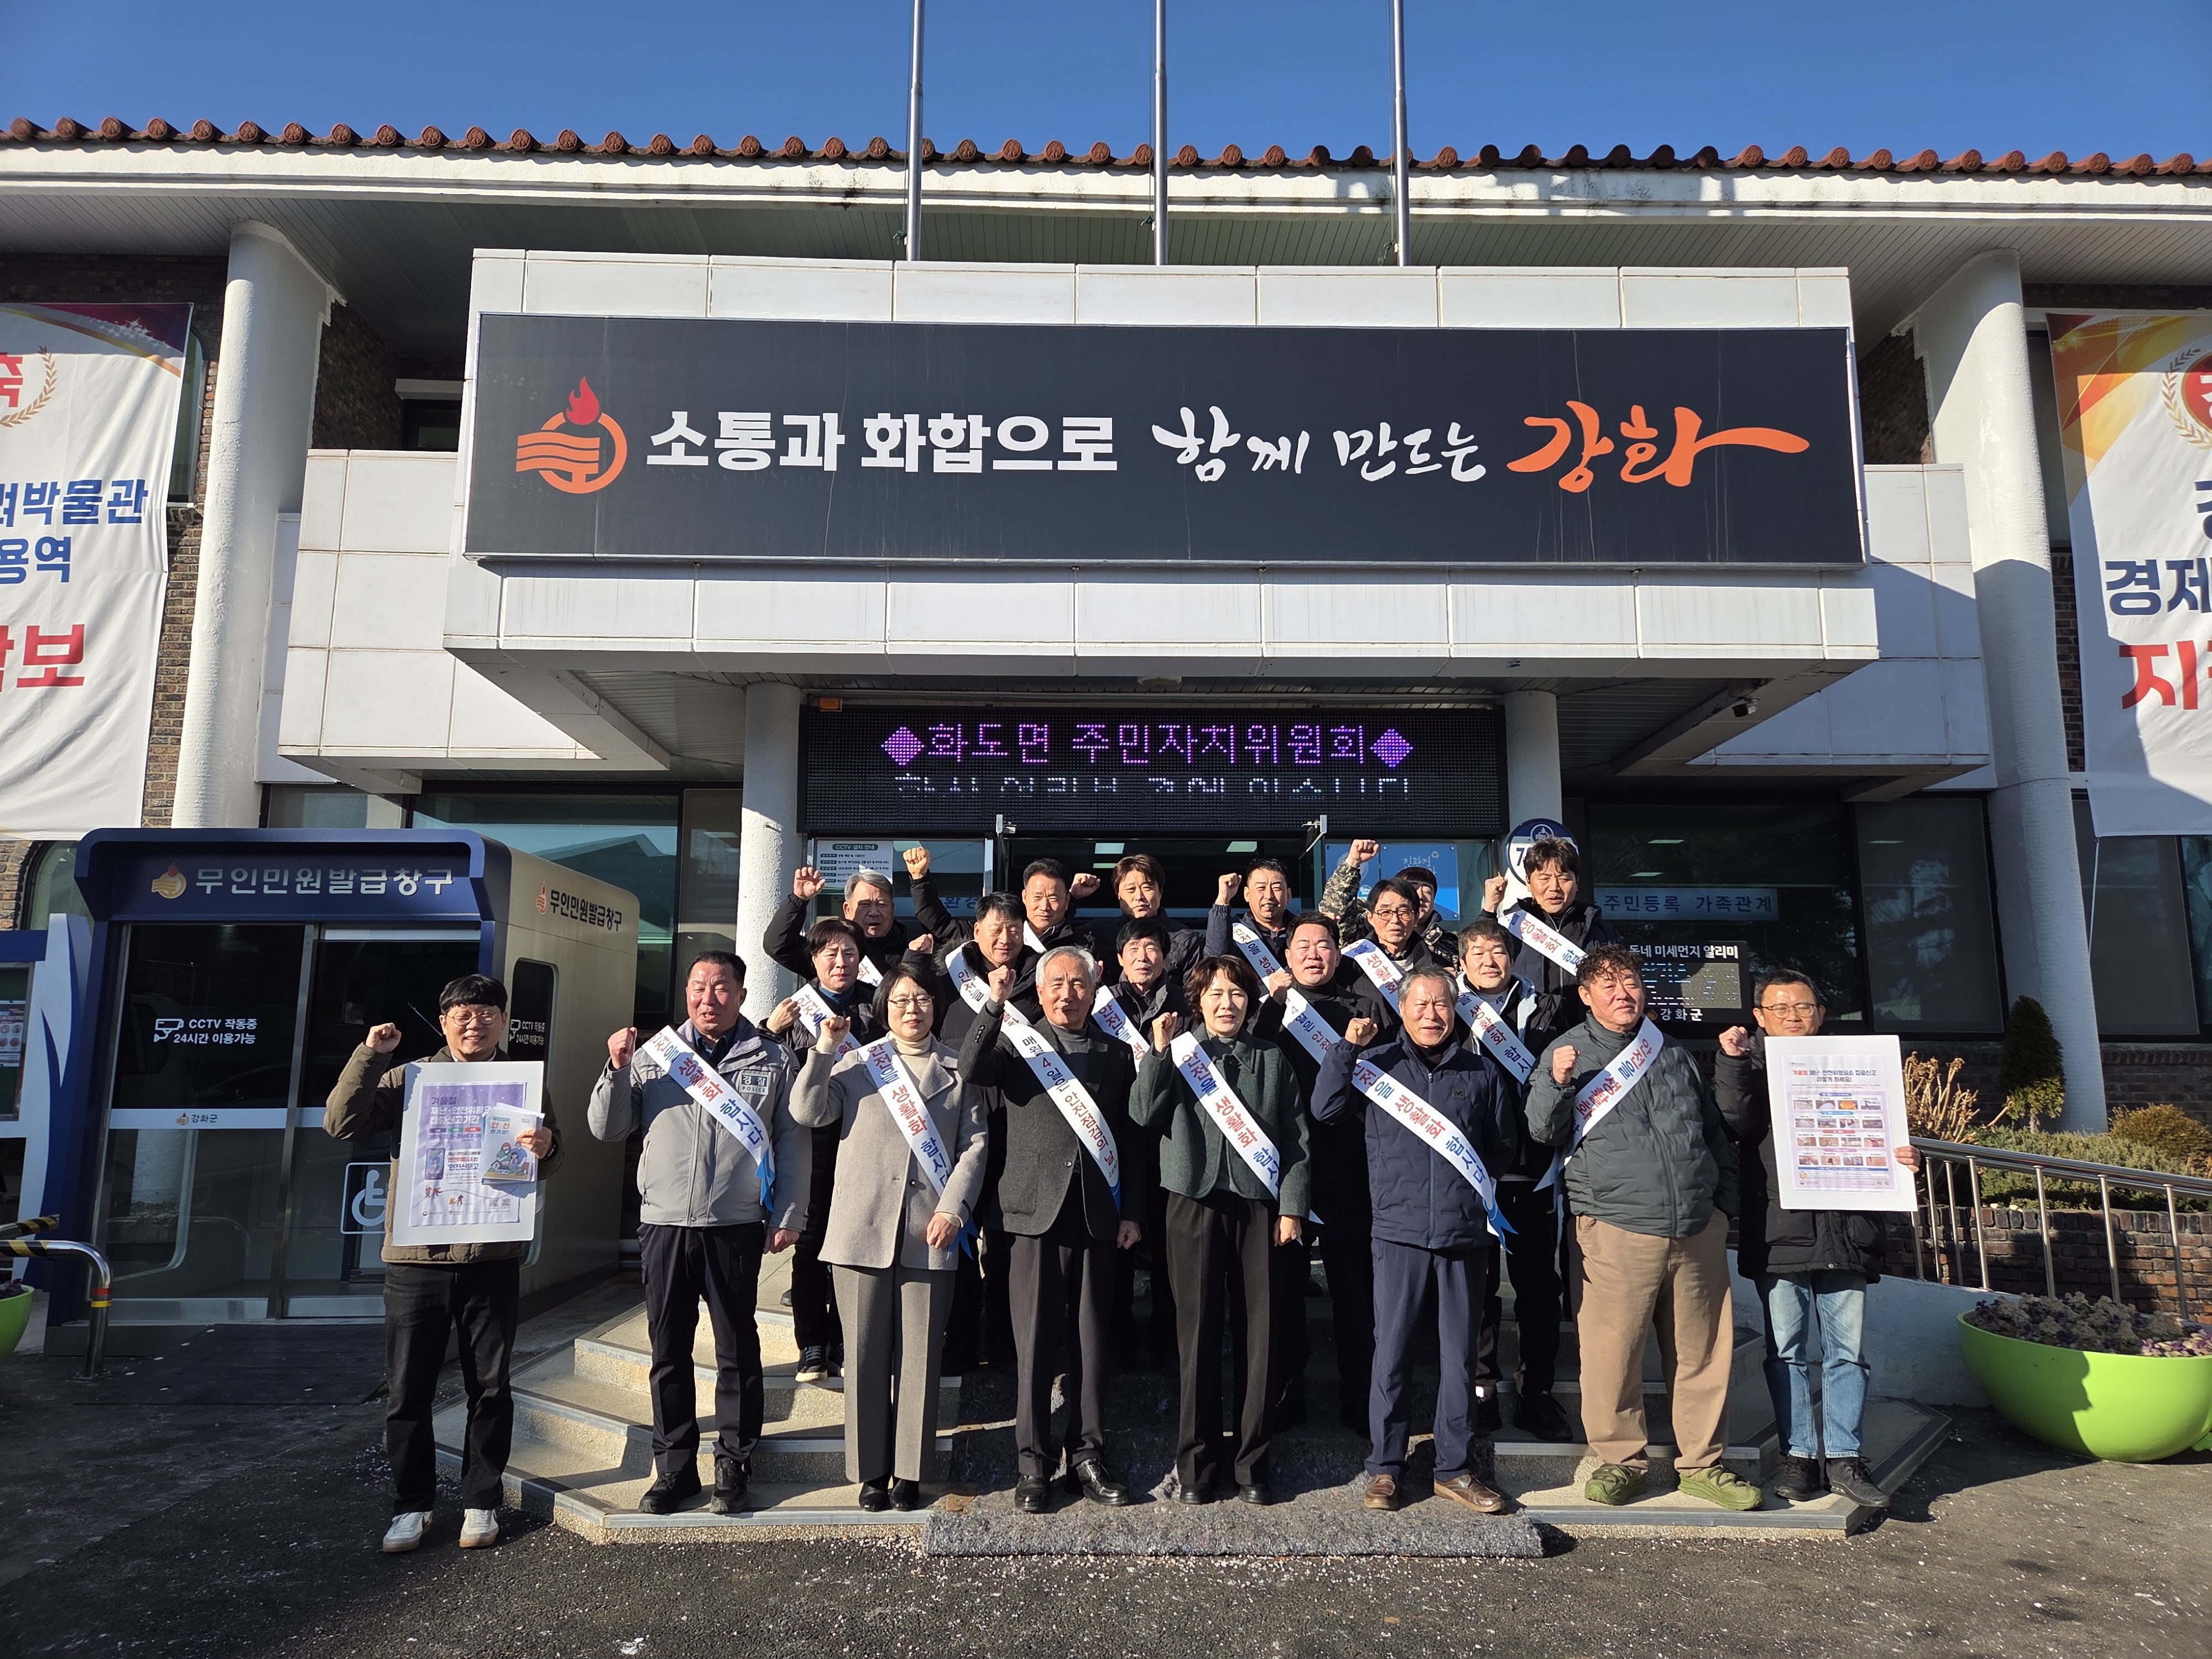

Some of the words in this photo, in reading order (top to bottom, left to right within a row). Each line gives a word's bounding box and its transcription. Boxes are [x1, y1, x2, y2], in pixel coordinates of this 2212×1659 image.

[646, 411, 846, 472] 소통과
[861, 412, 1118, 473] 화합으로
[1151, 405, 1310, 483] 함께
[1333, 421, 1487, 483] 만드는
[1507, 400, 1810, 493] 강화
[2119, 640, 2212, 709] 지
[927, 723, 1048, 763] 화도면
[1073, 724, 1364, 764] 주민자치위원회
[1516, 847, 1531, 867] 7
[196, 867, 454, 896] 무인민원발급창구
[550, 889, 623, 932] 무인민원발급창구
[1604, 895, 1680, 913] 주민등록
[1695, 895, 1772, 913] 가족관계
[1655, 945, 1700, 959] 미세먼지
[1703, 945, 1739, 959] 알리미
[189, 1019, 222, 1029] CCTV
[225, 1018, 258, 1030] 작동중
[1660, 1008, 1703, 1021] 강화군
[521, 1021, 534, 1031] CCTV
[173, 1033, 210, 1044] 24시간
[212, 1033, 256, 1044] 이용가능
[867, 1043, 900, 1085] 안전을
[431, 1097, 457, 1105] 겨울철
[191, 1114, 218, 1124] 강화군
[720, 1098, 764, 1146] 합시다
[1181, 1050, 1220, 1097] 안전을
[1253, 1147, 1280, 1187] 합시
[1103, 1150, 1115, 1166] 날
[1445, 1135, 1486, 1185] 합시다
